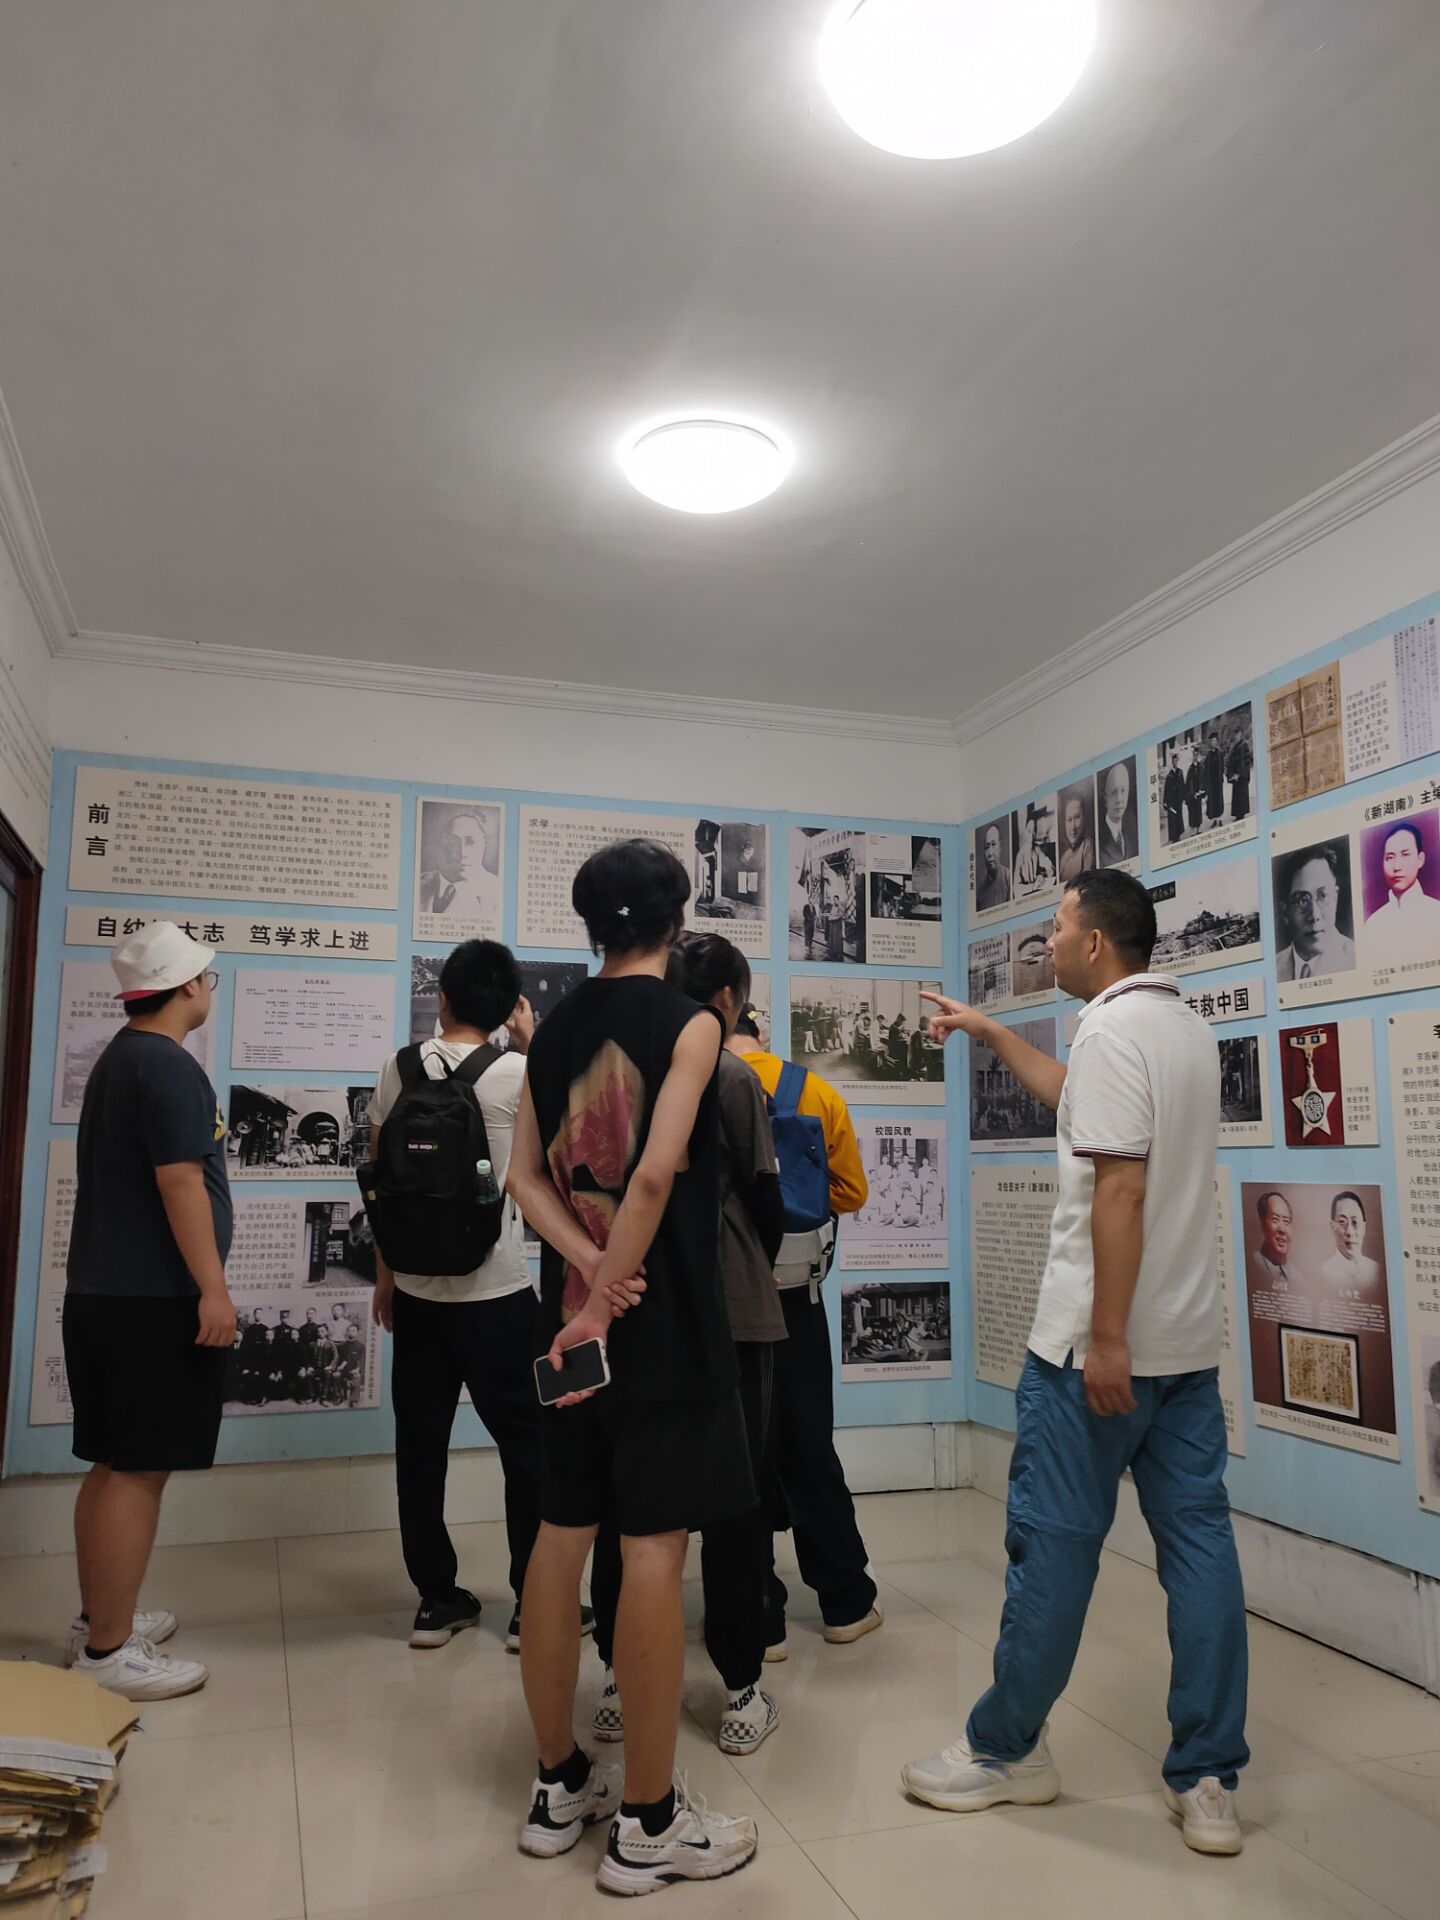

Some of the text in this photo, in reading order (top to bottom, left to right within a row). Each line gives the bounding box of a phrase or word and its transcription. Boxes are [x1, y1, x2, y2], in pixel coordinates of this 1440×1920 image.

[85, 803, 111, 857] 前言
[528, 818, 550, 829] 求学
[97, 916, 370, 951] 自幼大志 笃学求上进
[875, 1126, 912, 1136] 校园风貌
